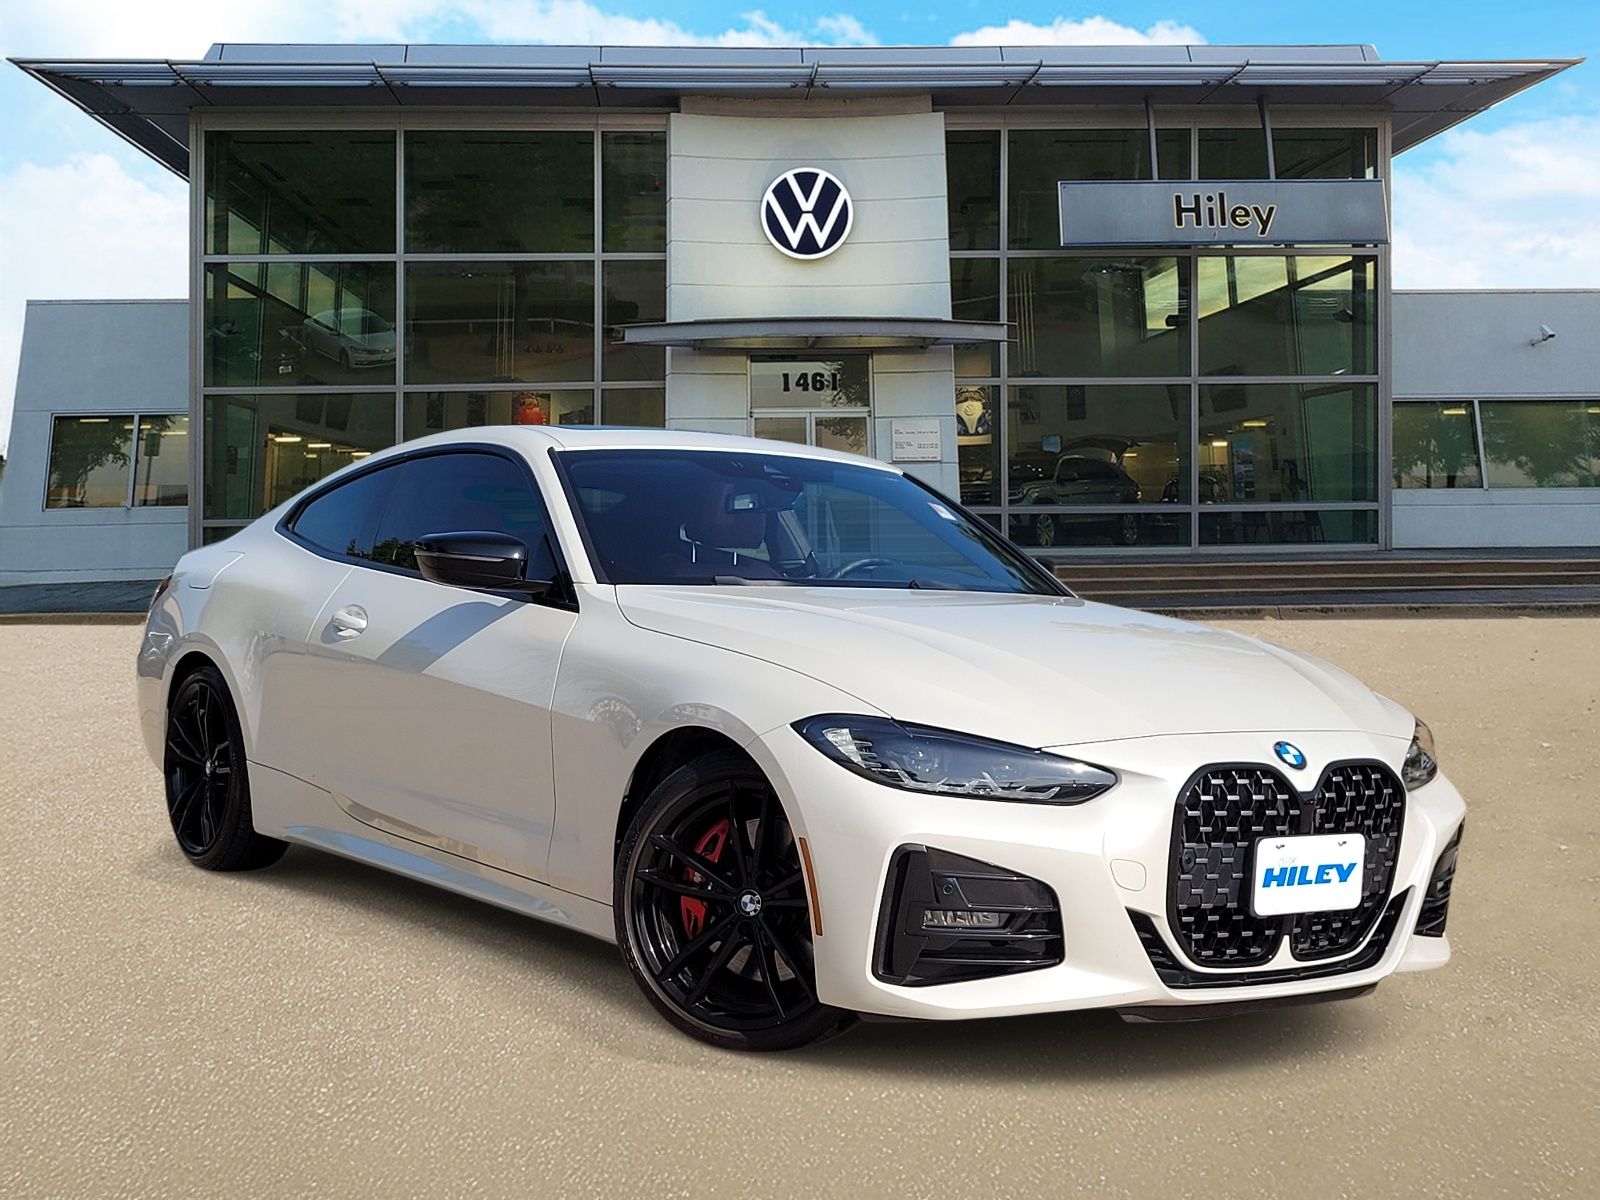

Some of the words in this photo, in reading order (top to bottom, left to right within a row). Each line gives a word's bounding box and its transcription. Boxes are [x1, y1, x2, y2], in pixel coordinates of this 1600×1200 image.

[1173, 192, 1277, 237] Hiley
[782, 372, 839, 392] 1461
[1261, 862, 1358, 888] HILEY
